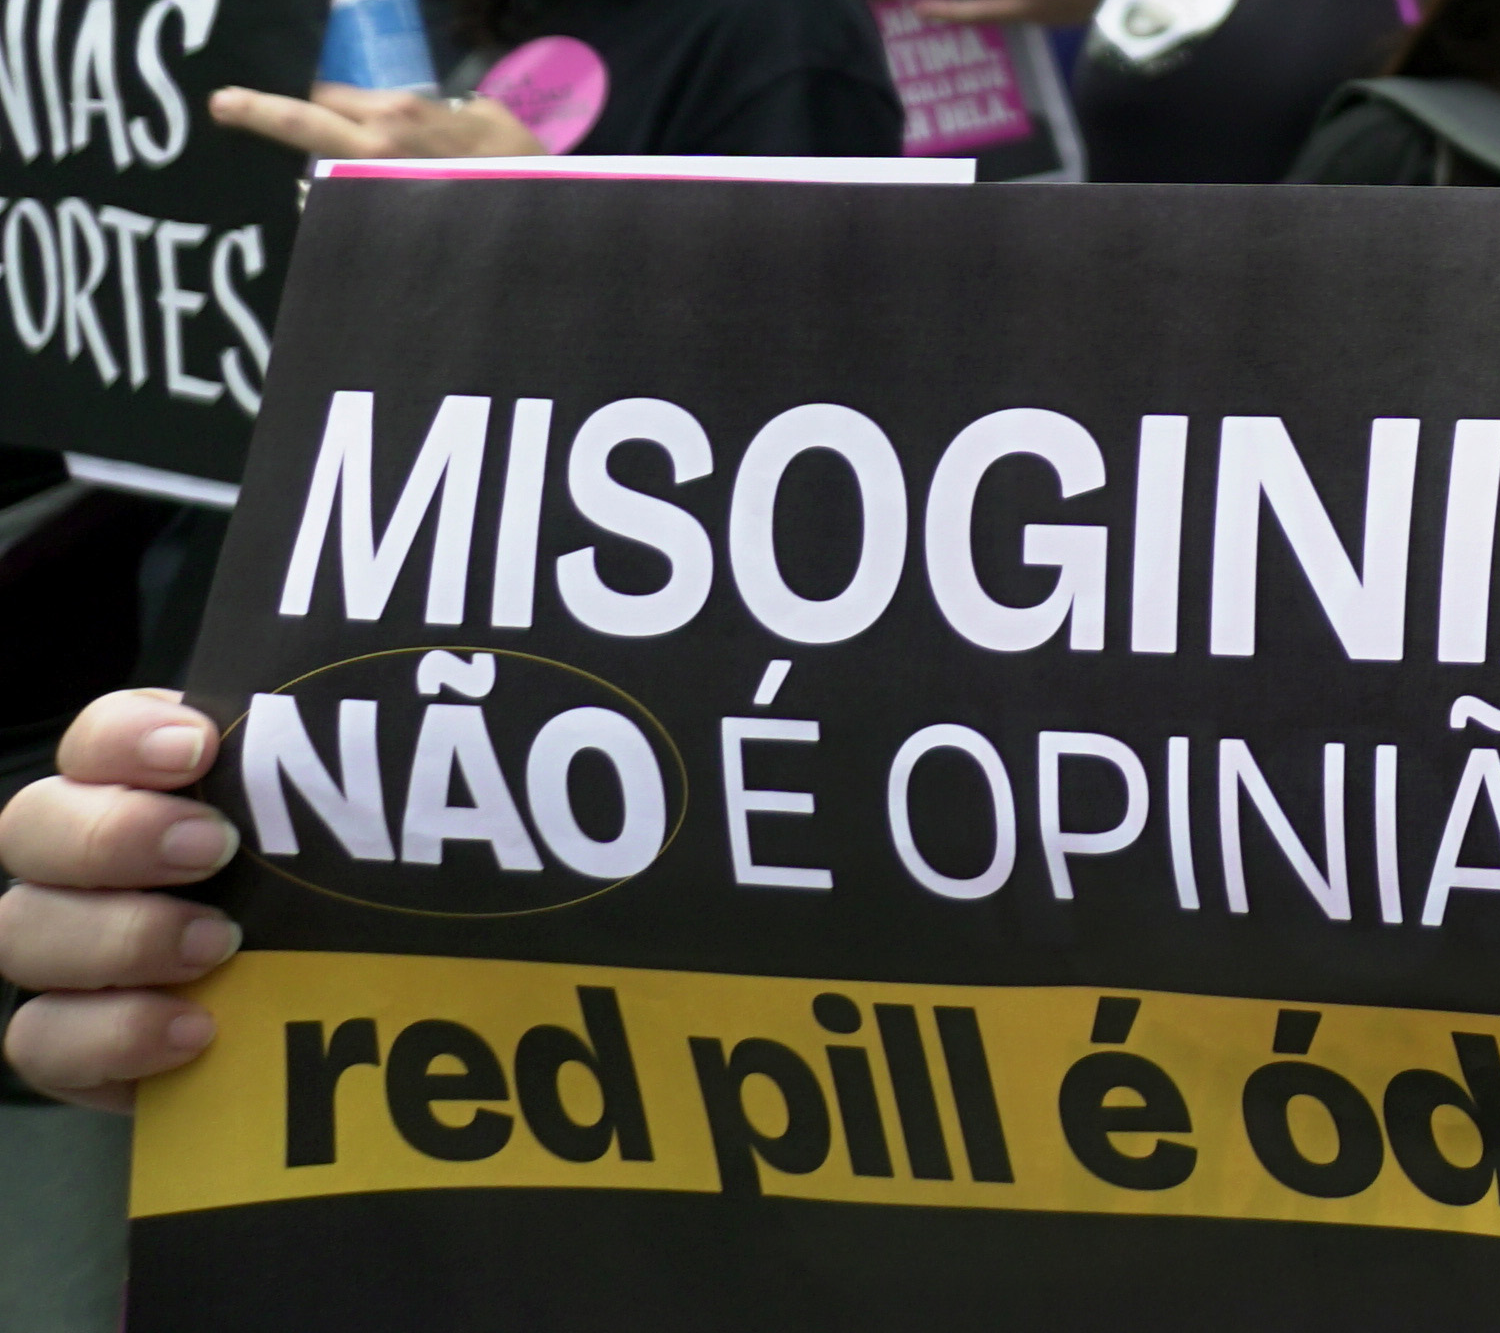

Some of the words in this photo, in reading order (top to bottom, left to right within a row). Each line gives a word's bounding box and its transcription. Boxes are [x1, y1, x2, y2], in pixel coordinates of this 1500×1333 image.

[0, 196, 270, 418] ORTES
[240, 652, 668, 879] NÃO
[721, 660, 834, 891] É
[284, 985, 654, 1169] red
[689, 991, 1014, 1196] pill
[1057, 995, 1199, 1192] é
